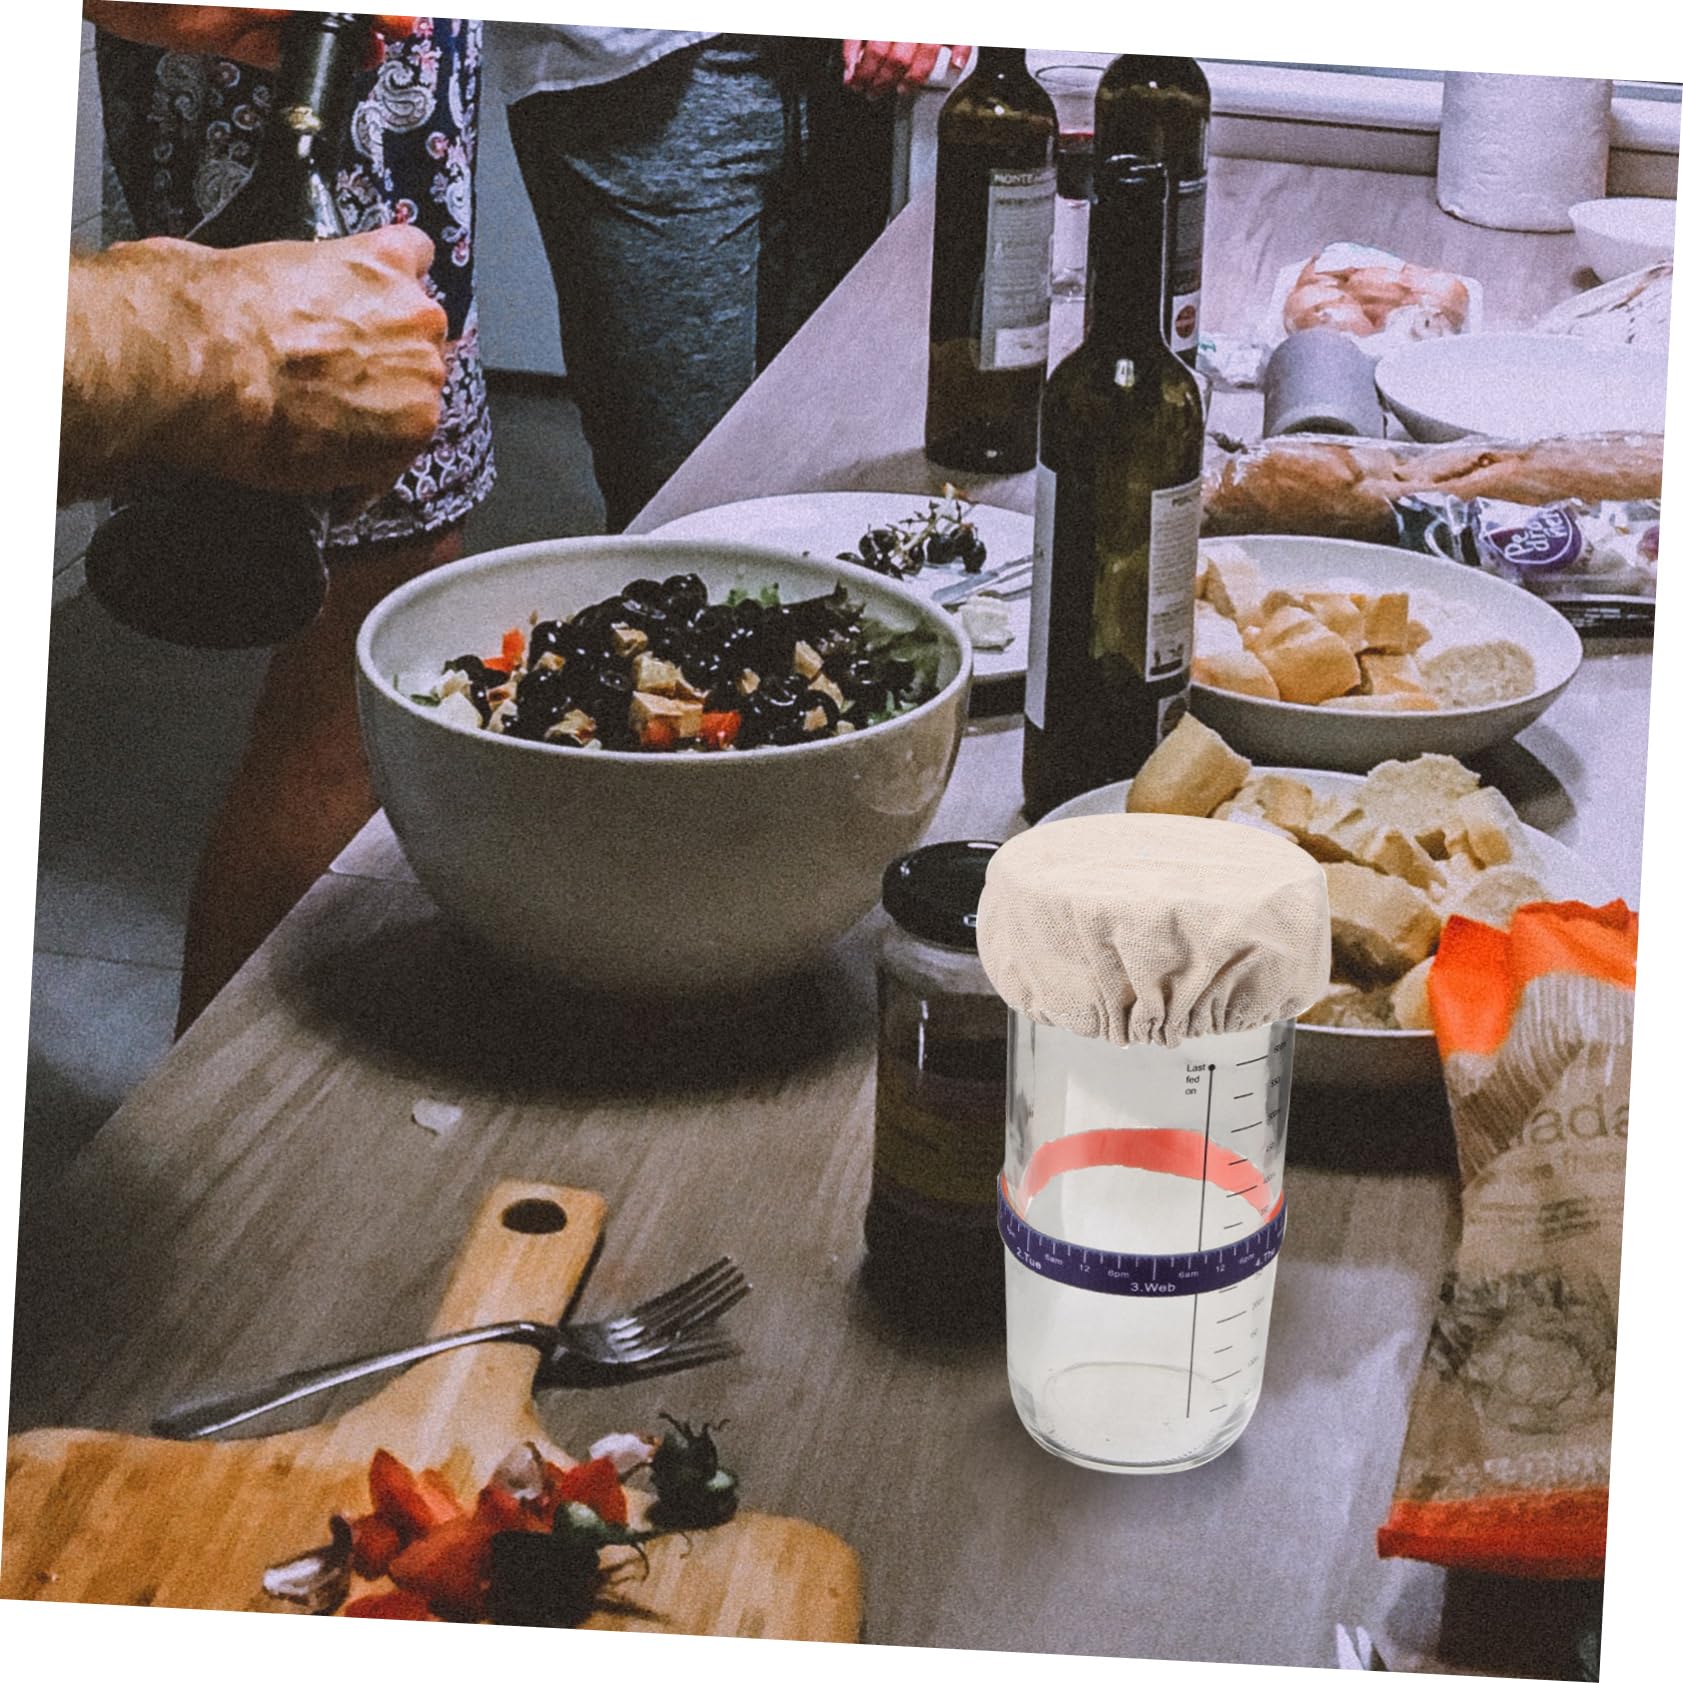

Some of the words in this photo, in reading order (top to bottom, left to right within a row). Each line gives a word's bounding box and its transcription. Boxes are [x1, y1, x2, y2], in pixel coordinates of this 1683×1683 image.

[1186, 1063, 1206, 1073] Last
[1185, 1075, 1201, 1084] fed
[1185, 1088, 1197, 1096] on
[1079, 1263, 1091, 1273] 12
[1178, 1270, 1200, 1279] 6am
[1215, 1263, 1226, 1273] 12
[1130, 1282, 1176, 1293] 3.Web
